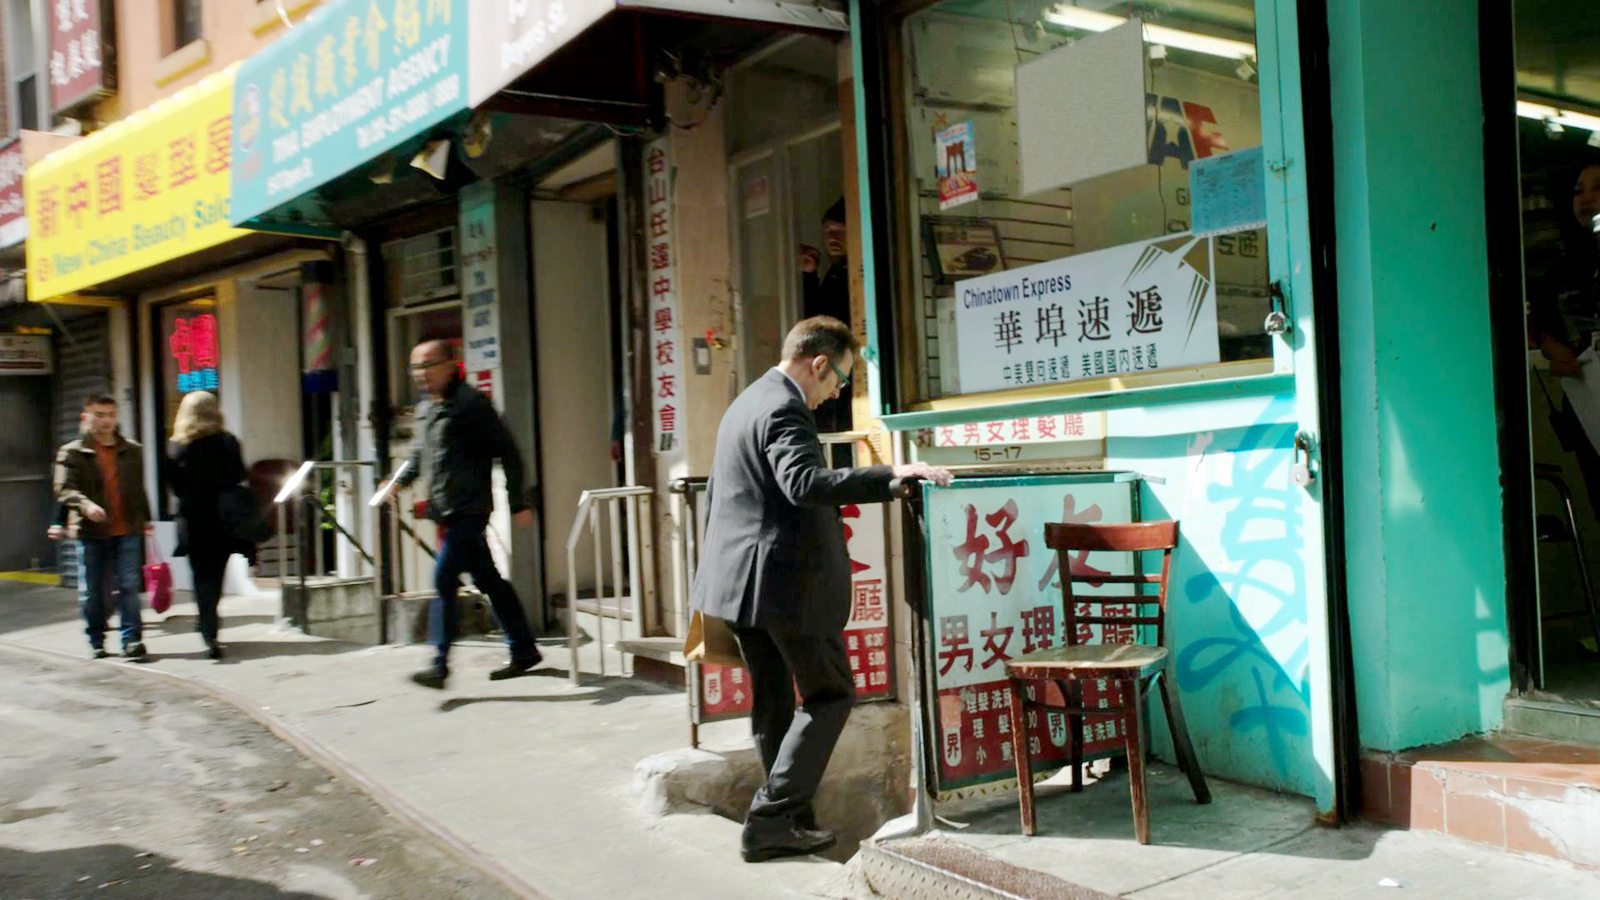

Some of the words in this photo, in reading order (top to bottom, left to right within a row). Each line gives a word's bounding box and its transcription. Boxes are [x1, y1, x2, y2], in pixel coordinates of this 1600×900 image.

[963, 282, 1020, 310] Chinatown
[1022, 273, 1072, 303] Express
[993, 284, 1164, 355] 華埠速遞
[973, 446, 1022, 462] 15-17
